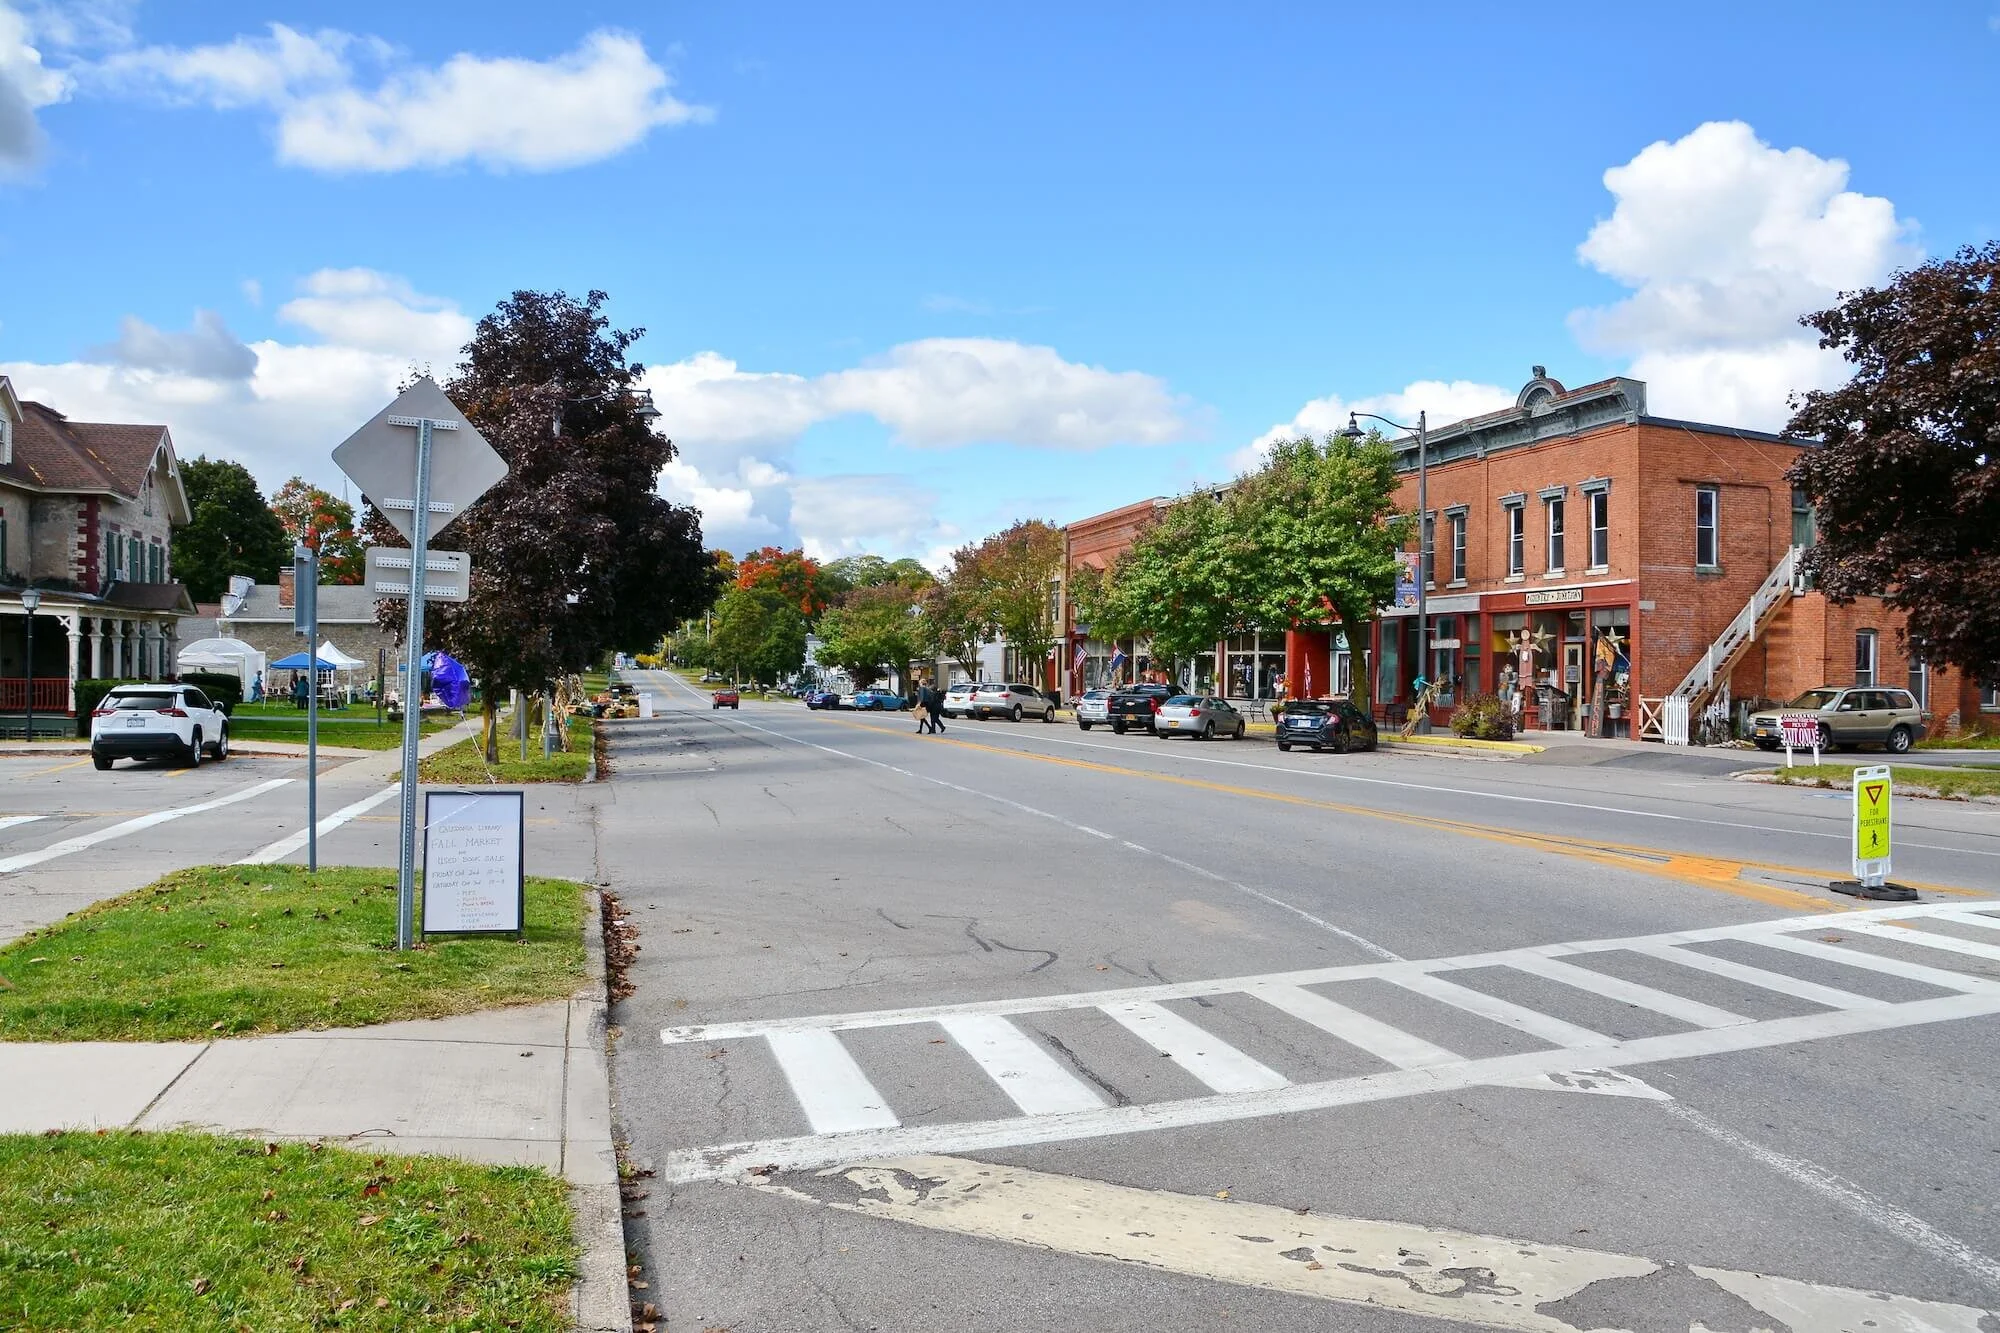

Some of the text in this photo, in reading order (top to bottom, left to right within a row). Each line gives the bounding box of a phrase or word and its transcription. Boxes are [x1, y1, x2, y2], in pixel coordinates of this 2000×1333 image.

[1783, 728, 1798, 744] EXIT
[1799, 728, 1816, 744] ONLY
[1869, 808, 1879, 816] FOR
[1860, 817, 1888, 827] PEDESTRIANS
[431, 837, 504, 849] FALL MARKET
[437, 855, 457, 865] USED
